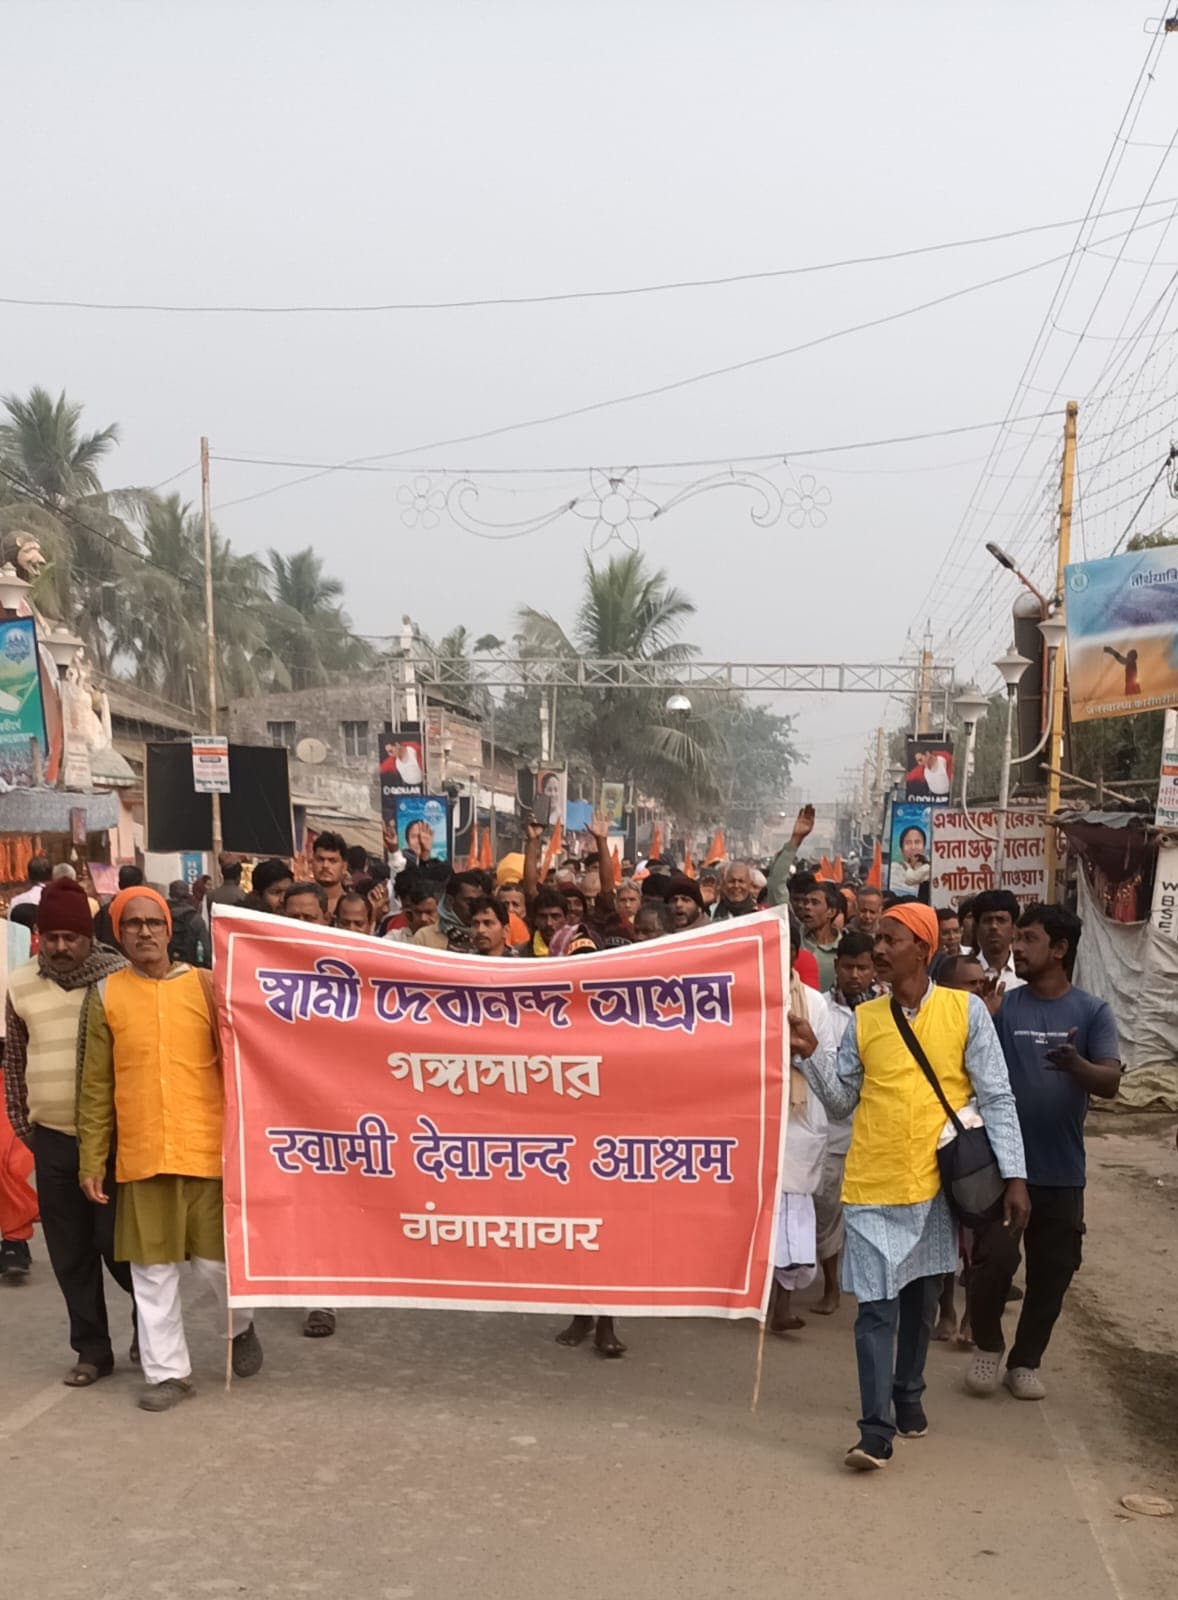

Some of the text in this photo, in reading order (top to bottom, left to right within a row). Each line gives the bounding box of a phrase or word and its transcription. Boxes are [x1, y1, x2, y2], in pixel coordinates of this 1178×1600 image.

[256, 958, 735, 1034] স্বামী দেবানন্দ আশ্রম
[387, 1051, 603, 1098] গঙ্গাসাগর
[266, 1114, 738, 1184] स्वामी देवानन्द आश्रम
[399, 1202, 603, 1252] गंगासागर
